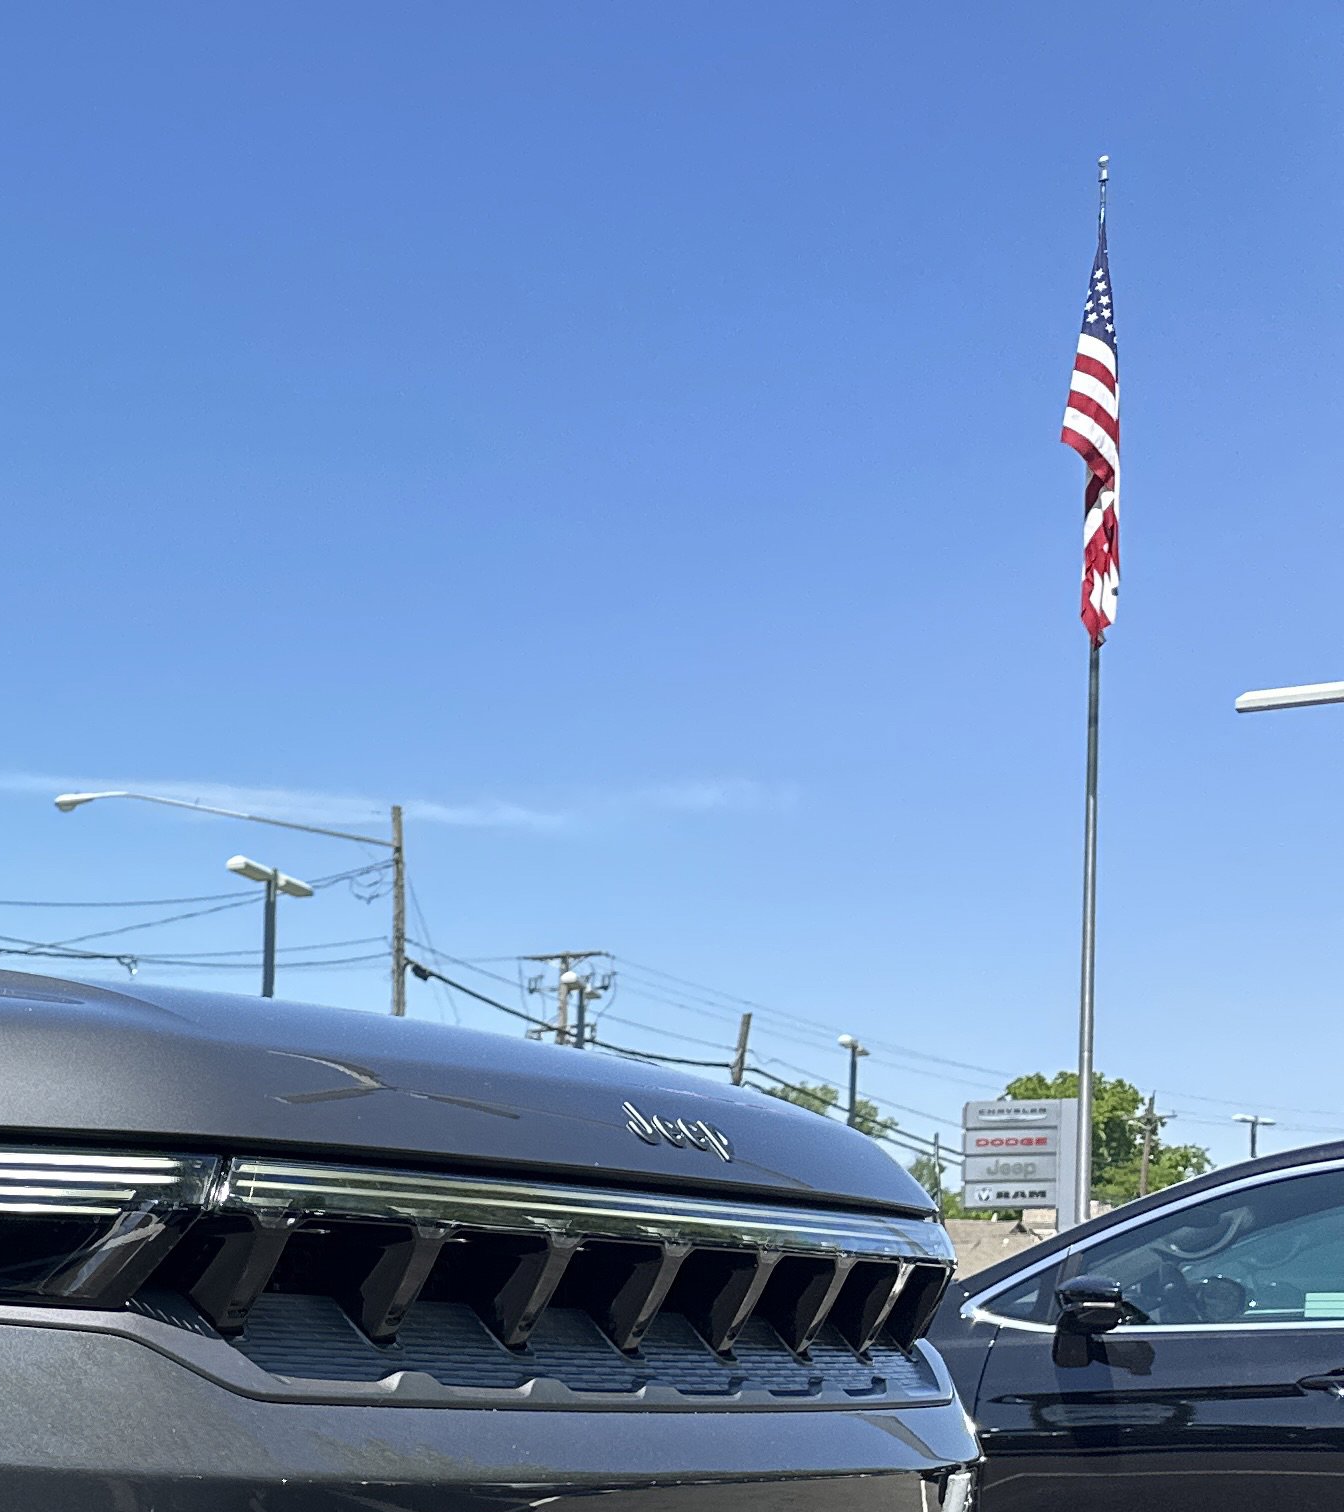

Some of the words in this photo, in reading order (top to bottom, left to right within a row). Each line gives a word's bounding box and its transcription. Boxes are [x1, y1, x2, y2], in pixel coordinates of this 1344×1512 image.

[978, 1106, 1047, 1115] CHRYSLER
[621, 1101, 735, 1163] Jeep
[976, 1137, 1047, 1147] DODGE
[986, 1159, 1037, 1178] Jeep
[996, 1190, 1046, 1198] RAM
